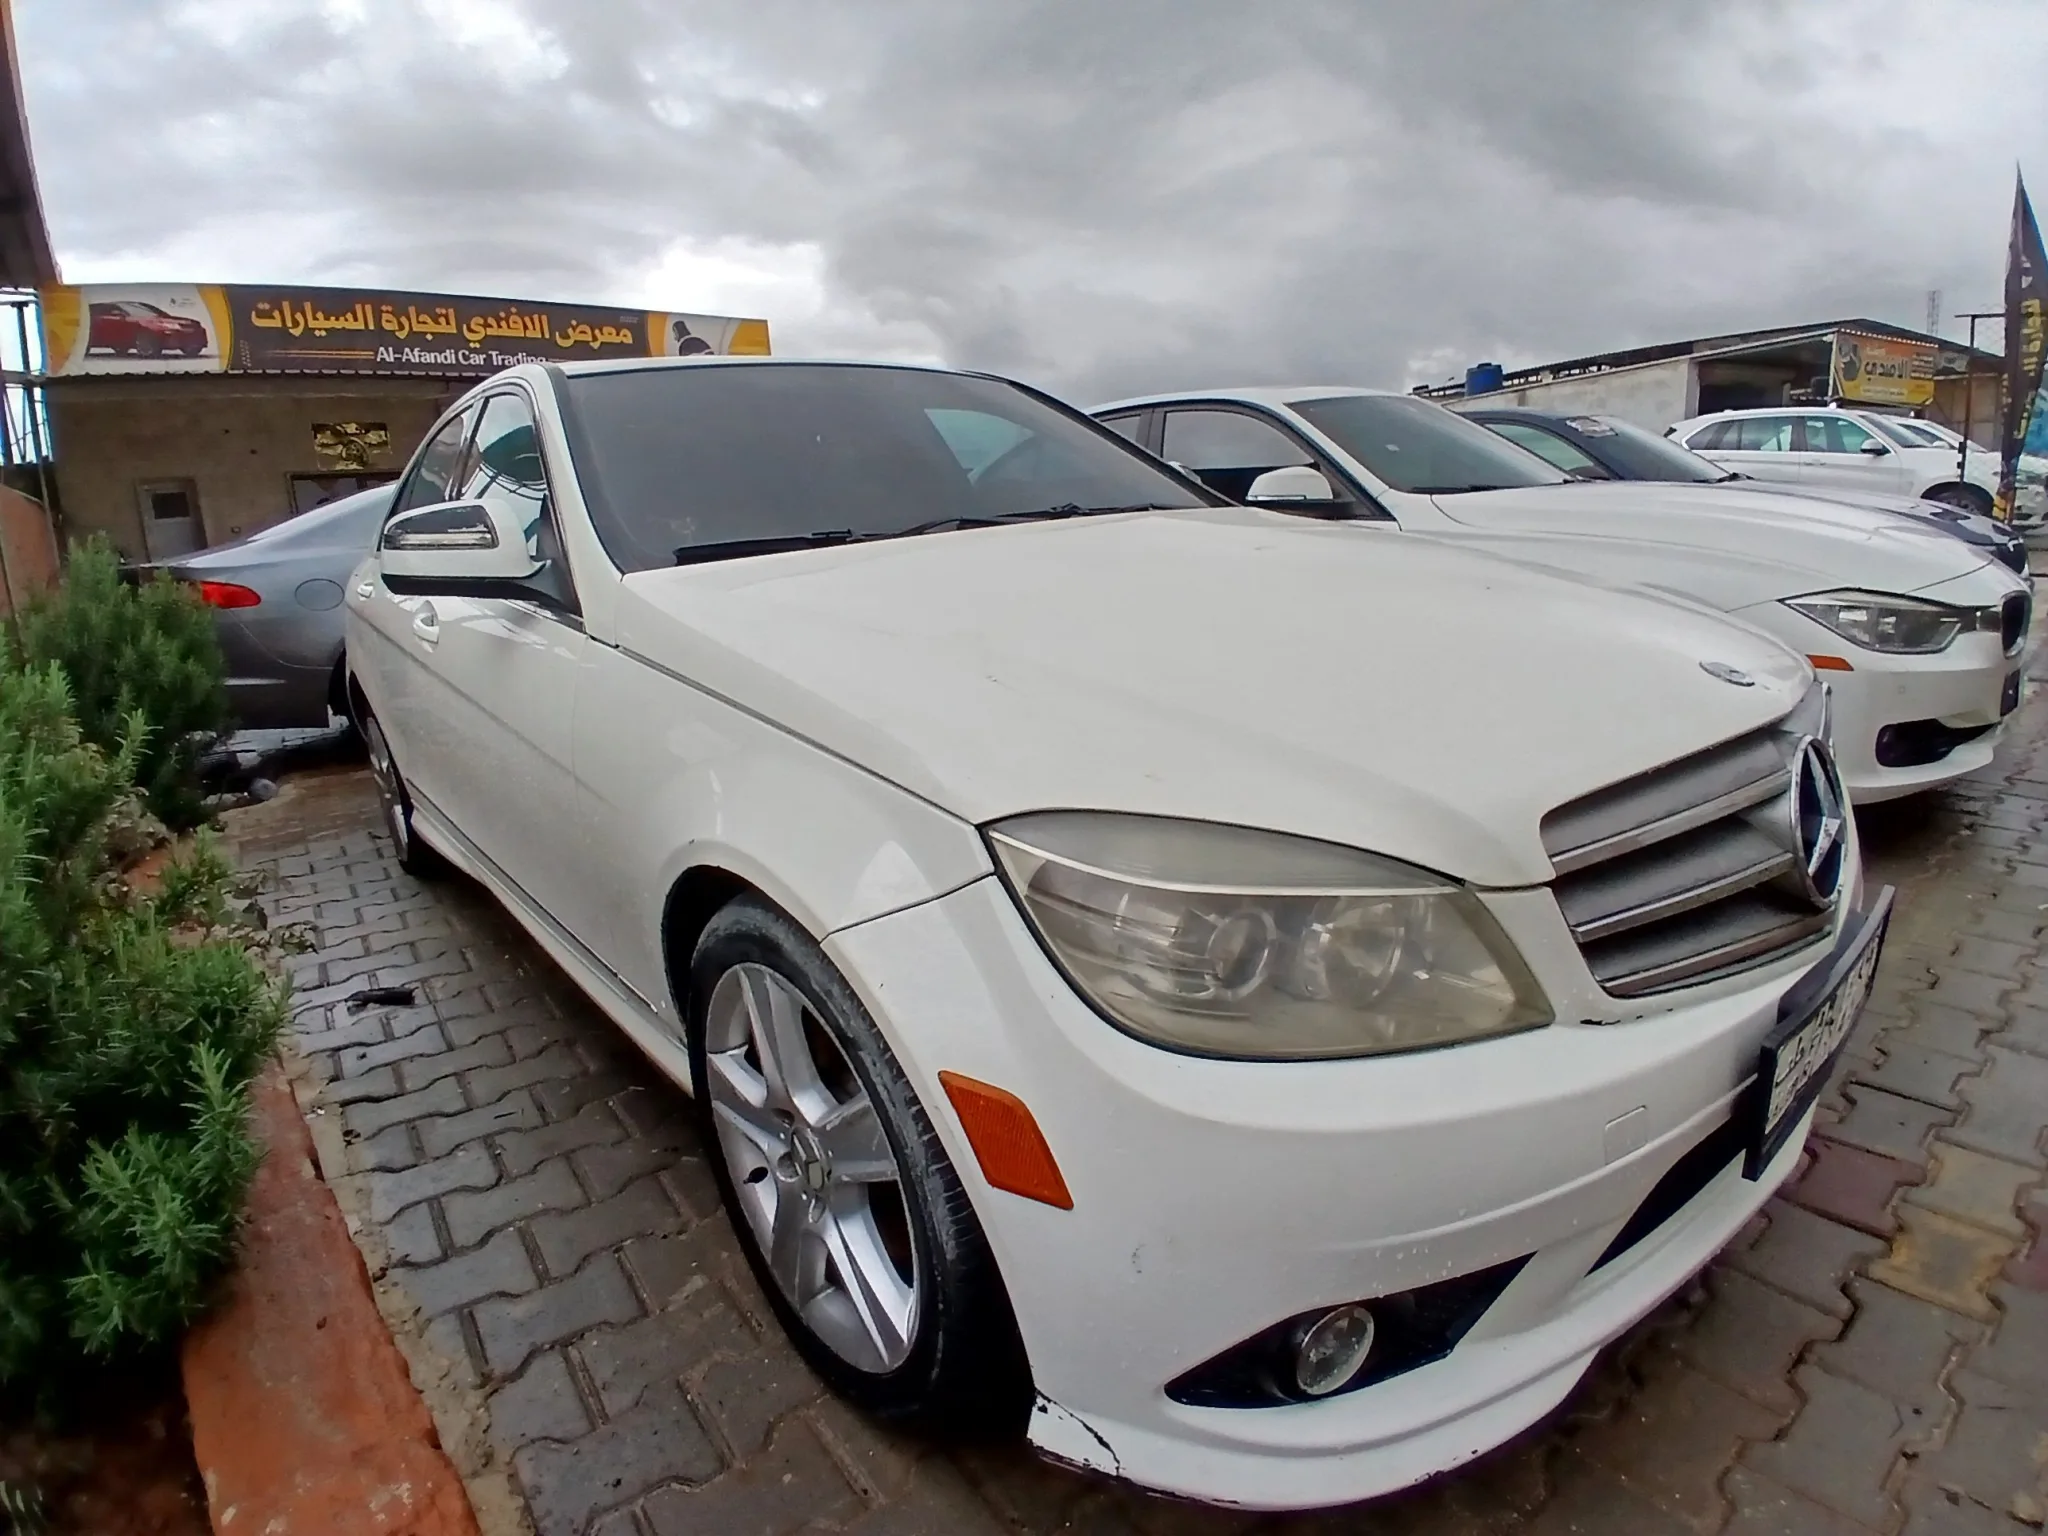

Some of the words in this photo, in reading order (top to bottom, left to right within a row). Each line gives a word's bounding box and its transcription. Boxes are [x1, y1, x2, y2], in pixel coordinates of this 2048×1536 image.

[251, 300, 375, 337] السيارات
[381, 304, 458, 341] لتجارة
[462, 306, 550, 349] الافندي
[555, 319, 634, 350] معرض
[376, 346, 456, 365] Al-Afandi
[458, 349, 487, 365] Car
